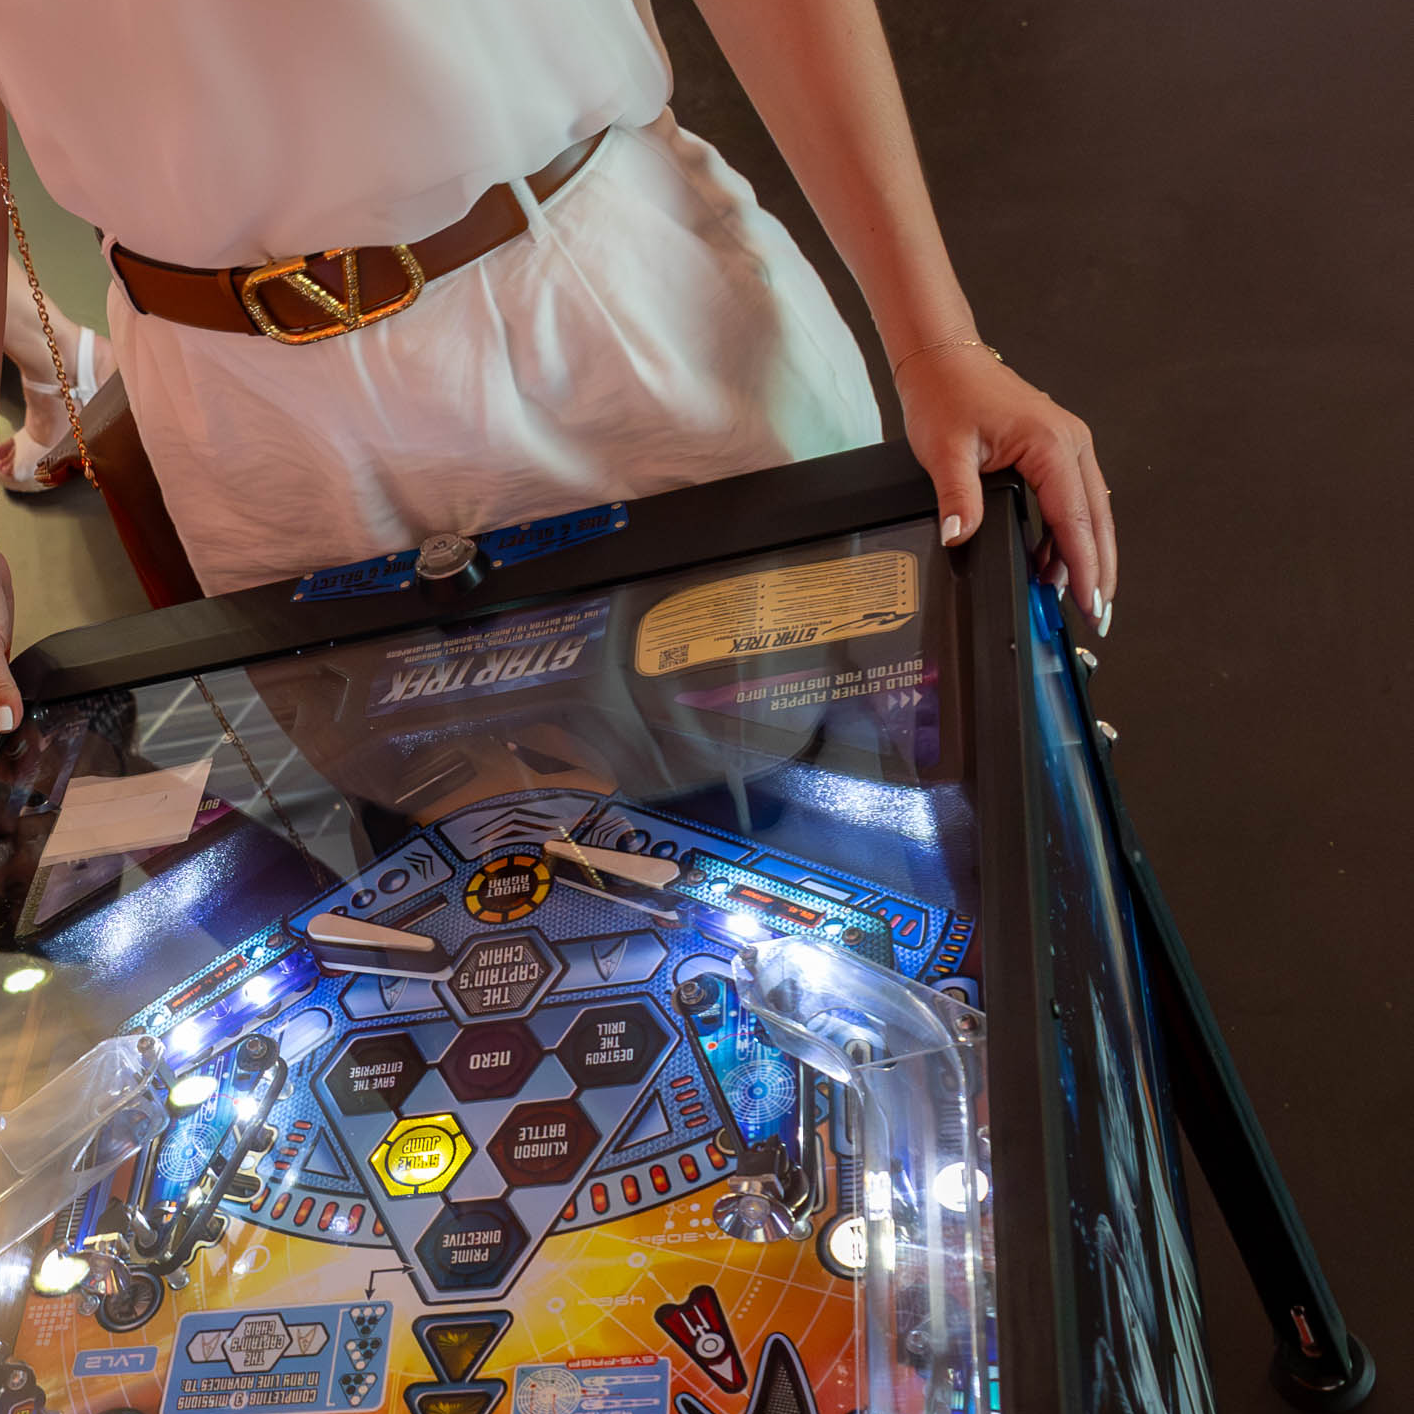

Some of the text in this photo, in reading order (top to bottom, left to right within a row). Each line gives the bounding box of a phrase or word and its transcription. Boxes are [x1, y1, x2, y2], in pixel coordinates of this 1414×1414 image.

[727, 634, 772, 653] TREK
[772, 628, 818, 645] STAR
[377, 634, 588, 704] STAR TREK
[736, 658, 923, 703] BUTTON FOR INSTANT INFO
[770, 674, 922, 711] HOLD EITHER FLIPPER
[488, 874, 529, 888] AGAIN
[486, 882, 530, 898] SHOOT
[478, 945, 523, 966] CHAIR
[459, 962, 539, 989] CAPTAIN'S
[482, 986, 510, 1006] THE
[596, 1021, 626, 1036] DRILL
[600, 1036, 620, 1049] THE
[470, 1050, 511, 1070] NERO
[586, 1048, 634, 1066] DESTROY
[349, 1062, 403, 1078] ENTERPRISE
[354, 1076, 396, 1091] SAVE THE
[518, 1123, 566, 1140] BATTLE
[402, 1135, 440, 1154] JUMP
[514, 1141, 568, 1160] KLINGON
[398, 1154, 440, 1170] SPACE
[442, 1230, 502, 1247] DIRECTIVE
[451, 1248, 489, 1264] PRIME
[244, 1321, 276, 1335] CHAIR
[231, 1334, 285, 1352] CAPTAIN'S
[85, 1354, 145, 1368] LVL2
[243, 1352, 264, 1367] THE
[568, 1356, 655, 1368] SYS-PREP
[200, 1376, 255, 1392] ADVANCES
[257, 1374, 281, 1388] LINE
[284, 1373, 304, 1388] ANY
[306, 1372, 320, 1386] IN
[178, 1395, 231, 1410] MISSIONS
[249, 1389, 317, 1406] COMPLETING
